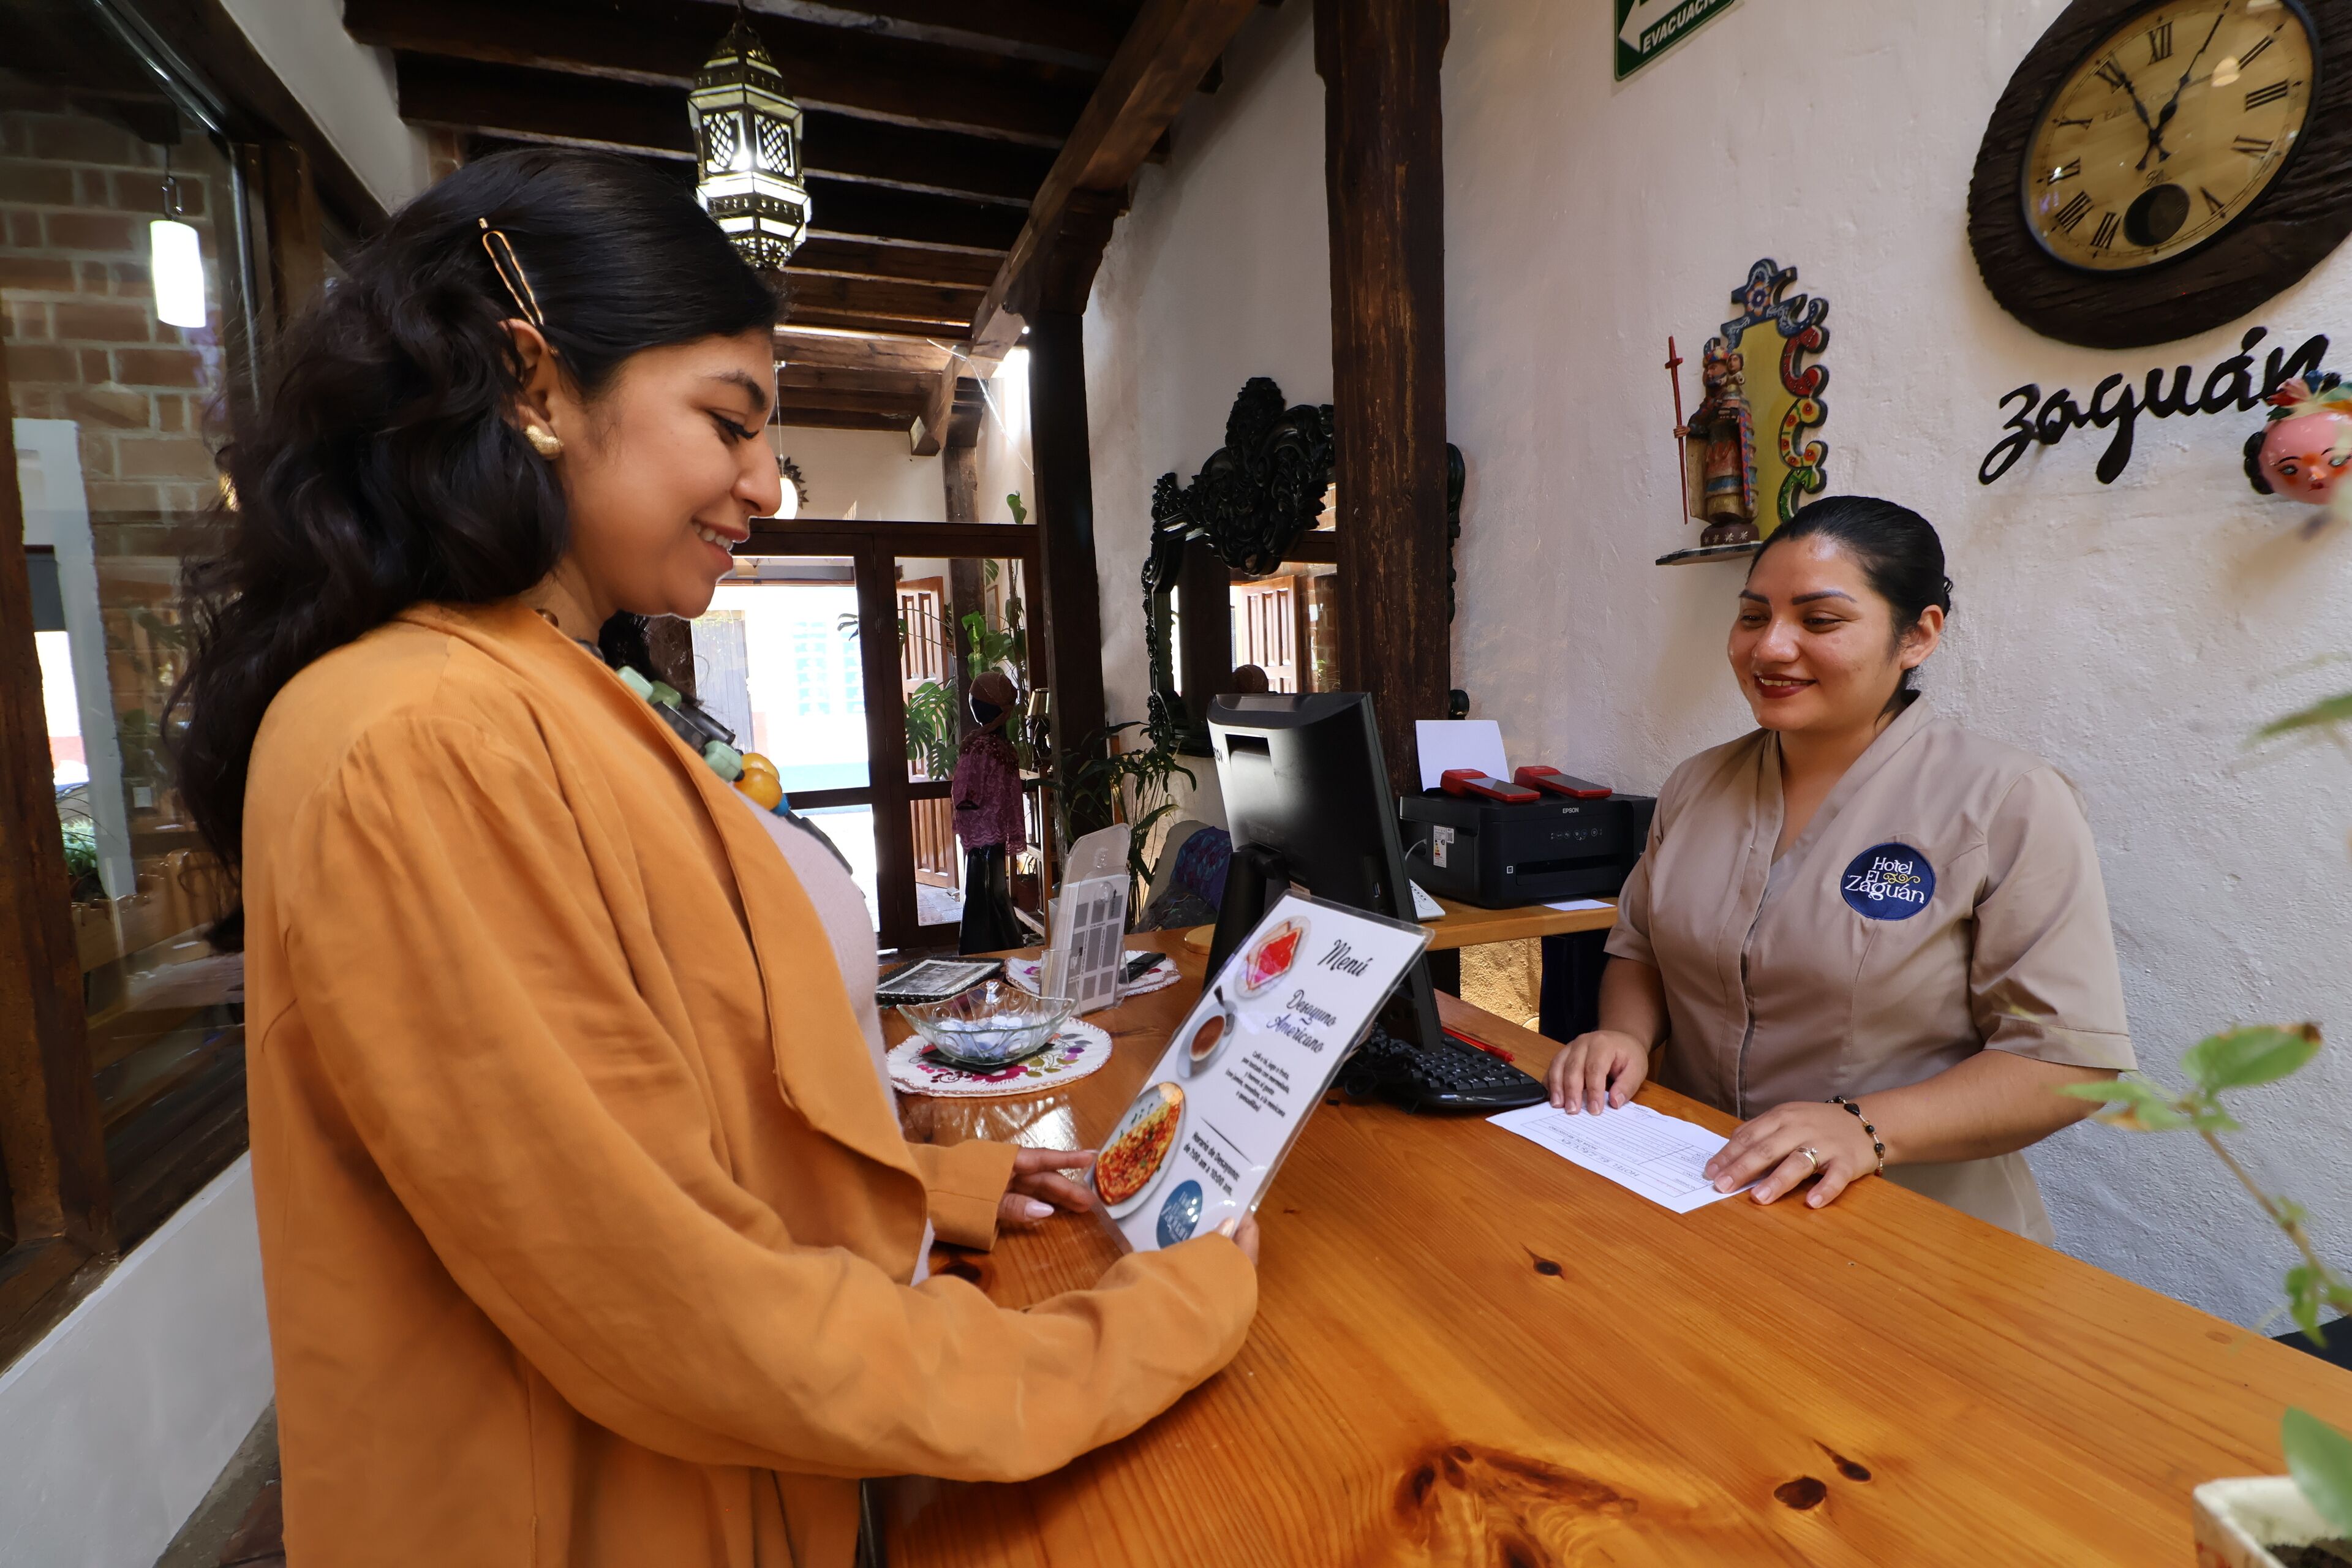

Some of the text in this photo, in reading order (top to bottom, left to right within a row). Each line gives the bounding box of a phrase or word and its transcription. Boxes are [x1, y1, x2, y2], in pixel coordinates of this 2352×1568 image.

[2148, 20, 2174, 66] XII
[2244, 78, 2290, 113] III
[1866, 870, 1880, 883] El
[1872, 857, 1913, 875] Hotel
[1845, 875, 1925, 904] Zaguán
[1317, 939, 1373, 976] Menú
[1286, 989, 1337, 1027] Desayuno
[1266, 1014, 1324, 1054] Americano
